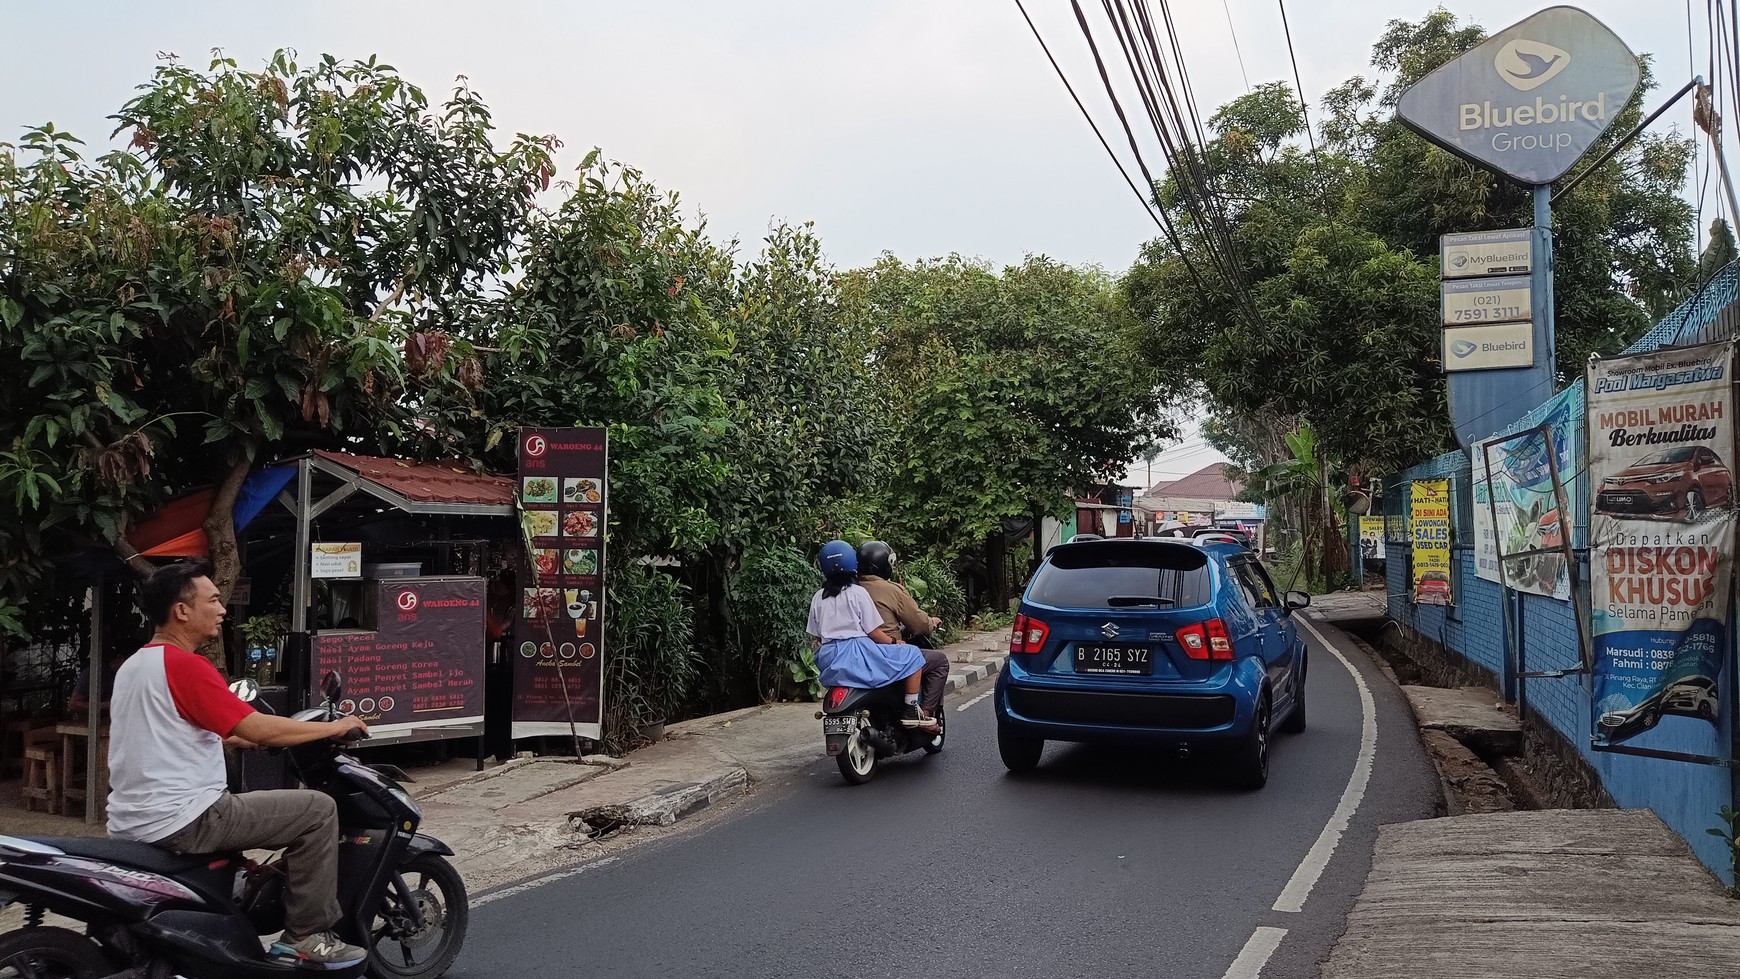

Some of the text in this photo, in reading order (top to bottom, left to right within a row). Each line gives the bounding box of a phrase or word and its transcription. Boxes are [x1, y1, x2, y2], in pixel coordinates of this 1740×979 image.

[1459, 92, 1605, 131] Bluebird
[1491, 132, 1572, 152] Group
[1482, 232, 1502, 240] Lewat
[1470, 253, 1528, 265] MyBlueBird
[1473, 295, 1501, 306] (021)
[1455, 306, 1520, 320] 7591 3111
[1482, 341, 1526, 352] Bluebird
[1607, 367, 1644, 377] Showroom
[1644, 363, 1664, 372] Mobil
[1678, 357, 1712, 368] Bluebird
[1595, 366, 1724, 394] Pool Margasatwa
[1600, 401, 1723, 429] MOBIL MURAH
[1609, 424, 1717, 447] Berkualitas
[1424, 508, 1435, 516] SINI
[1436, 508, 1446, 516] ADA
[1416, 528, 1447, 540] SALES
[1616, 532, 1709, 547] Dapatkan
[1416, 542, 1448, 550] USED CAR
[1606, 546, 1717, 576] DISKON
[1609, 576, 1715, 606] KHUSUS
[423, 599, 468, 608] WAROENG
[1609, 600, 1714, 621] Selama Pamean
[320, 634, 375, 644] Sego Pecel
[320, 641, 434, 654] Nasi Ayam Goreng Keju
[1606, 647, 1644, 658] Marsudi
[320, 655, 381, 664] Nasi Padang
[1078, 648, 1148, 662] B 2165 SYZ
[348, 666, 370, 674] Ayam
[376, 662, 408, 671] Goreng
[412, 661, 438, 669] Korea
[1612, 658, 1644, 669] Fahmi
[348, 669, 464, 684] Ayam Penyet Sambel Ijo
[1610, 674, 1630, 682] Pinang
[348, 679, 474, 695] Ayam Penyet Sambel Merah
